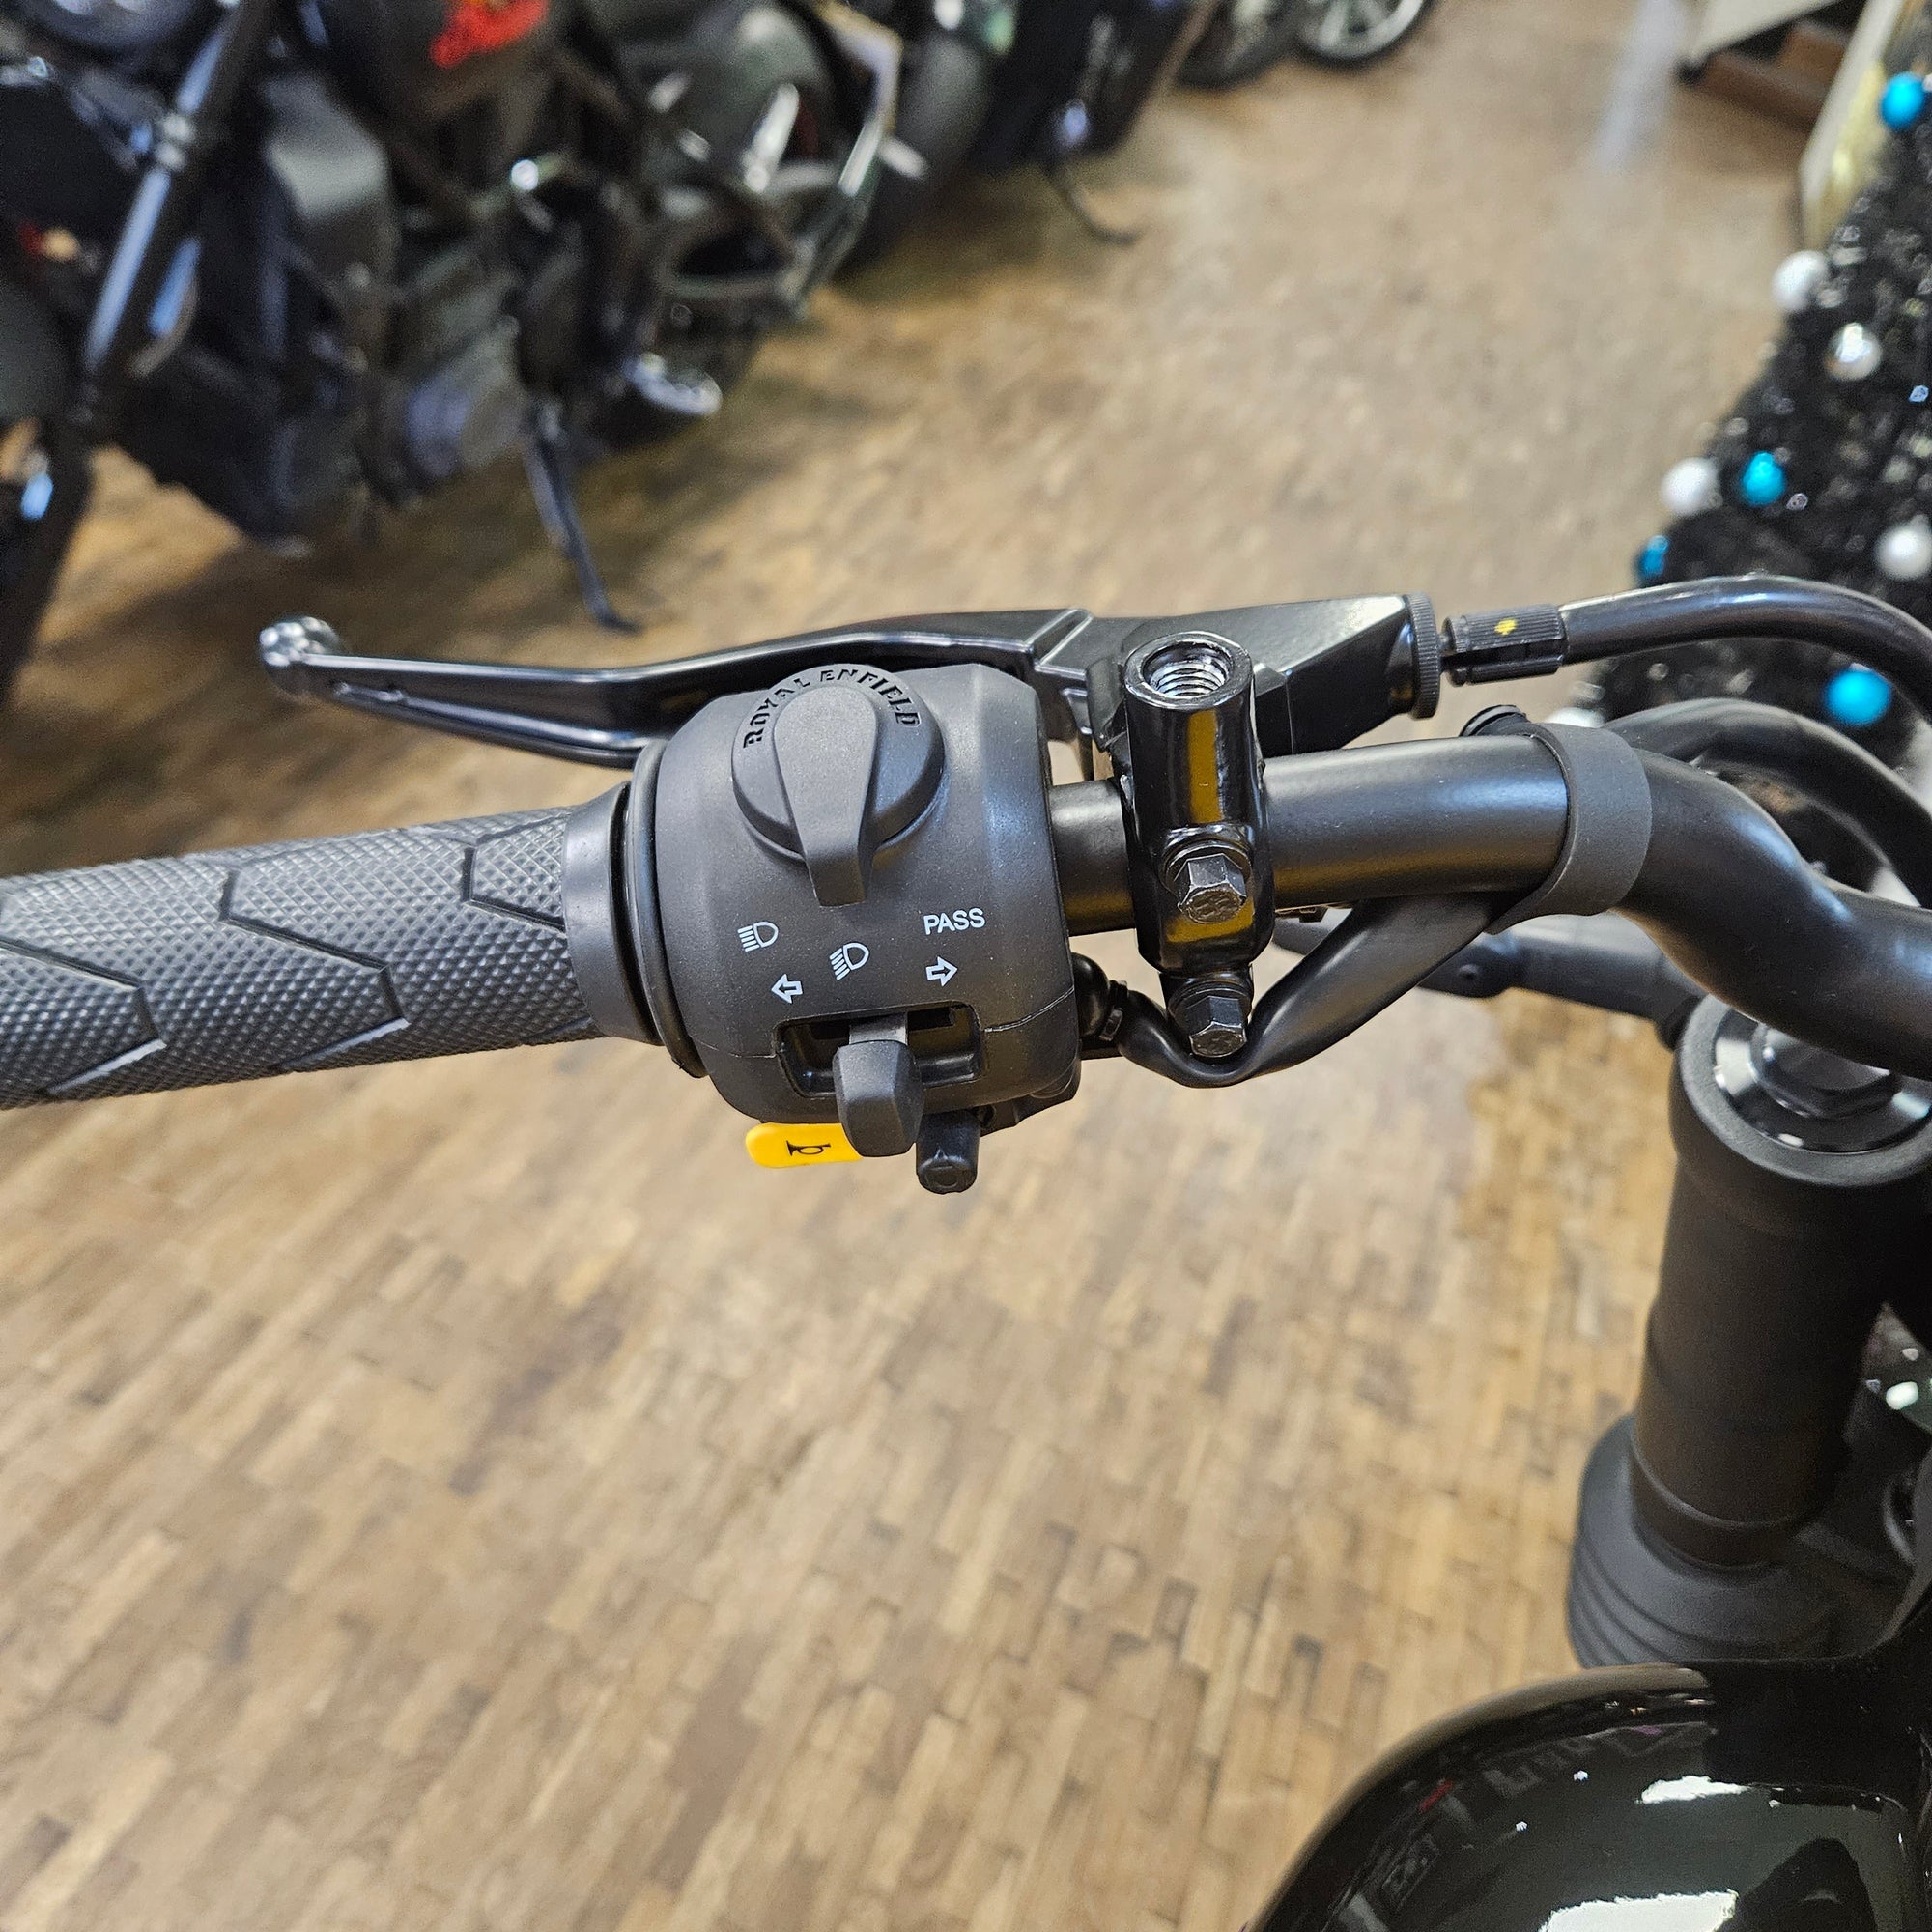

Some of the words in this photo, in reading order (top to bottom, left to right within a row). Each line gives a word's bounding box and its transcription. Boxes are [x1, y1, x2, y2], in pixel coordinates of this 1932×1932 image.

[743, 677, 810, 748] ROYAL
[819, 668, 923, 727] ENFIELD
[923, 907, 985, 935] PASS
